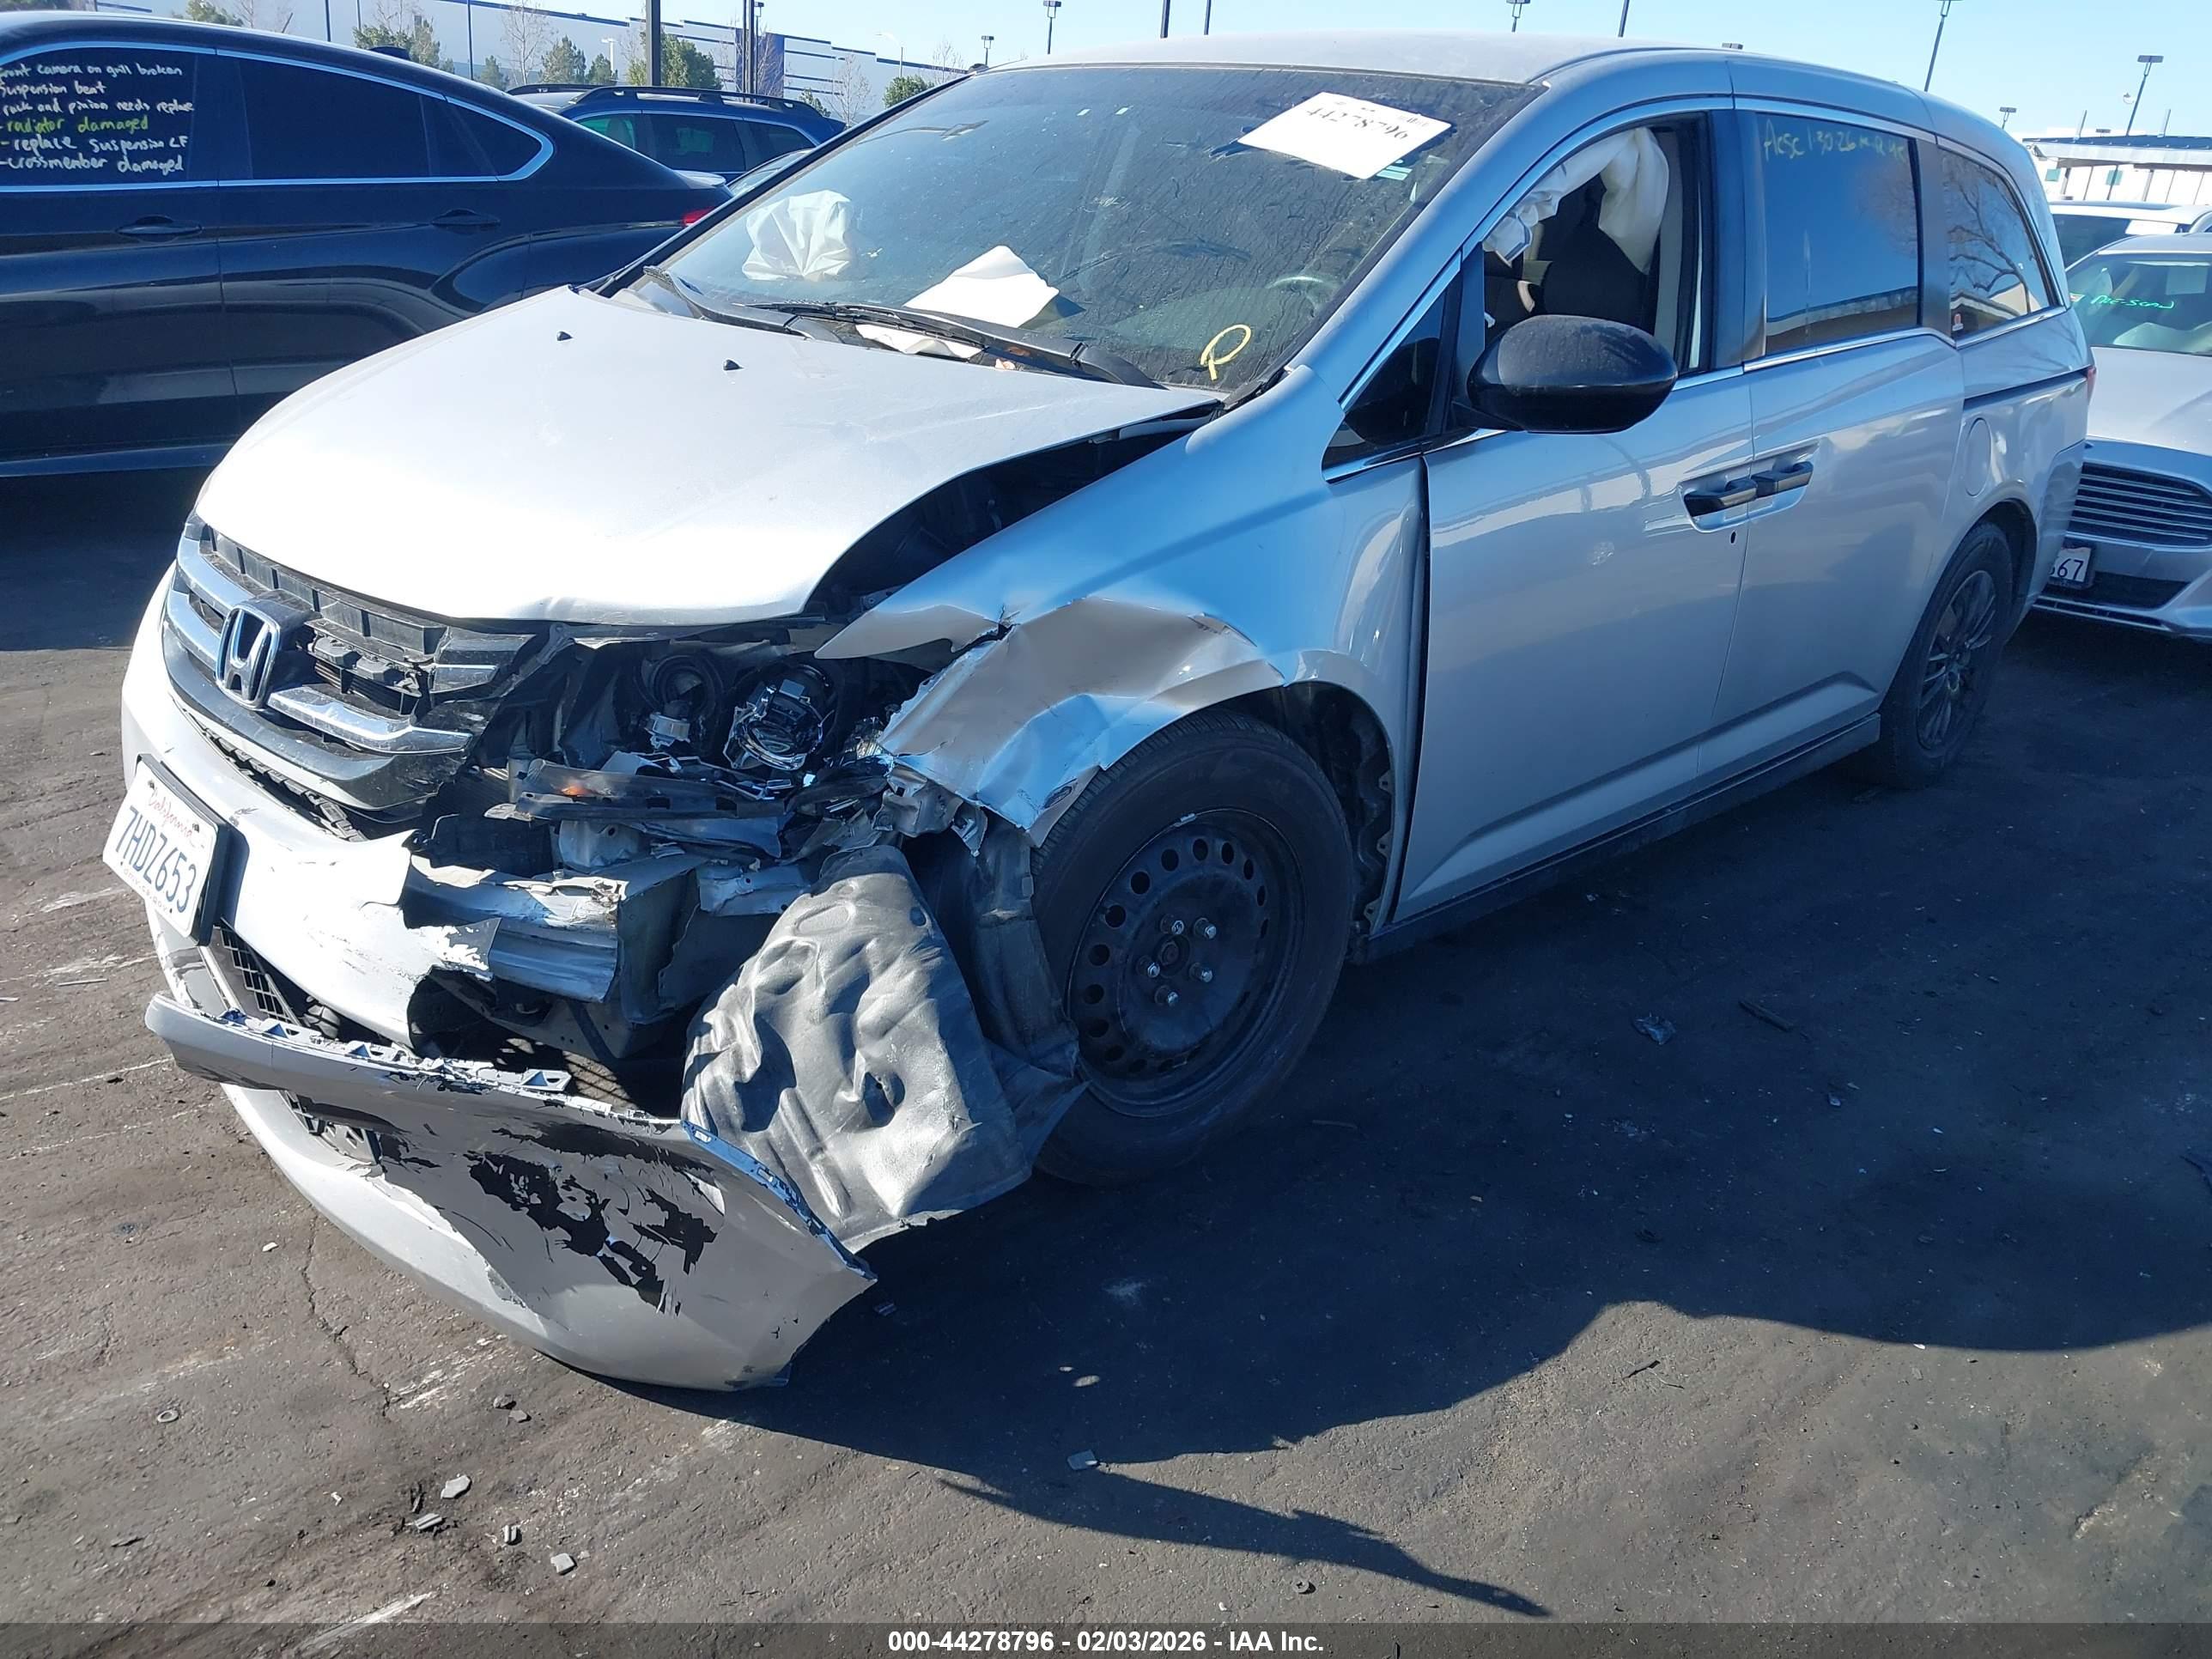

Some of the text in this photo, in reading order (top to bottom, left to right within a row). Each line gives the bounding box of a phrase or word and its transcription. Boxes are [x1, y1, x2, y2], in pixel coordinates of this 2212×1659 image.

[37, 64, 83, 75] camera
[87, 65, 102, 74] on
[106, 64, 132, 78] grill
[136, 63, 183, 76] broken
[37, 97, 64, 112] and
[116, 99, 150, 111] needs
[78, 114, 149, 134] damaged
[169, 136, 188, 147] LF
[117, 155, 184, 176] damaged
[2050, 558, 2084, 580] 67
[115, 805, 197, 913] 7HDZ653
